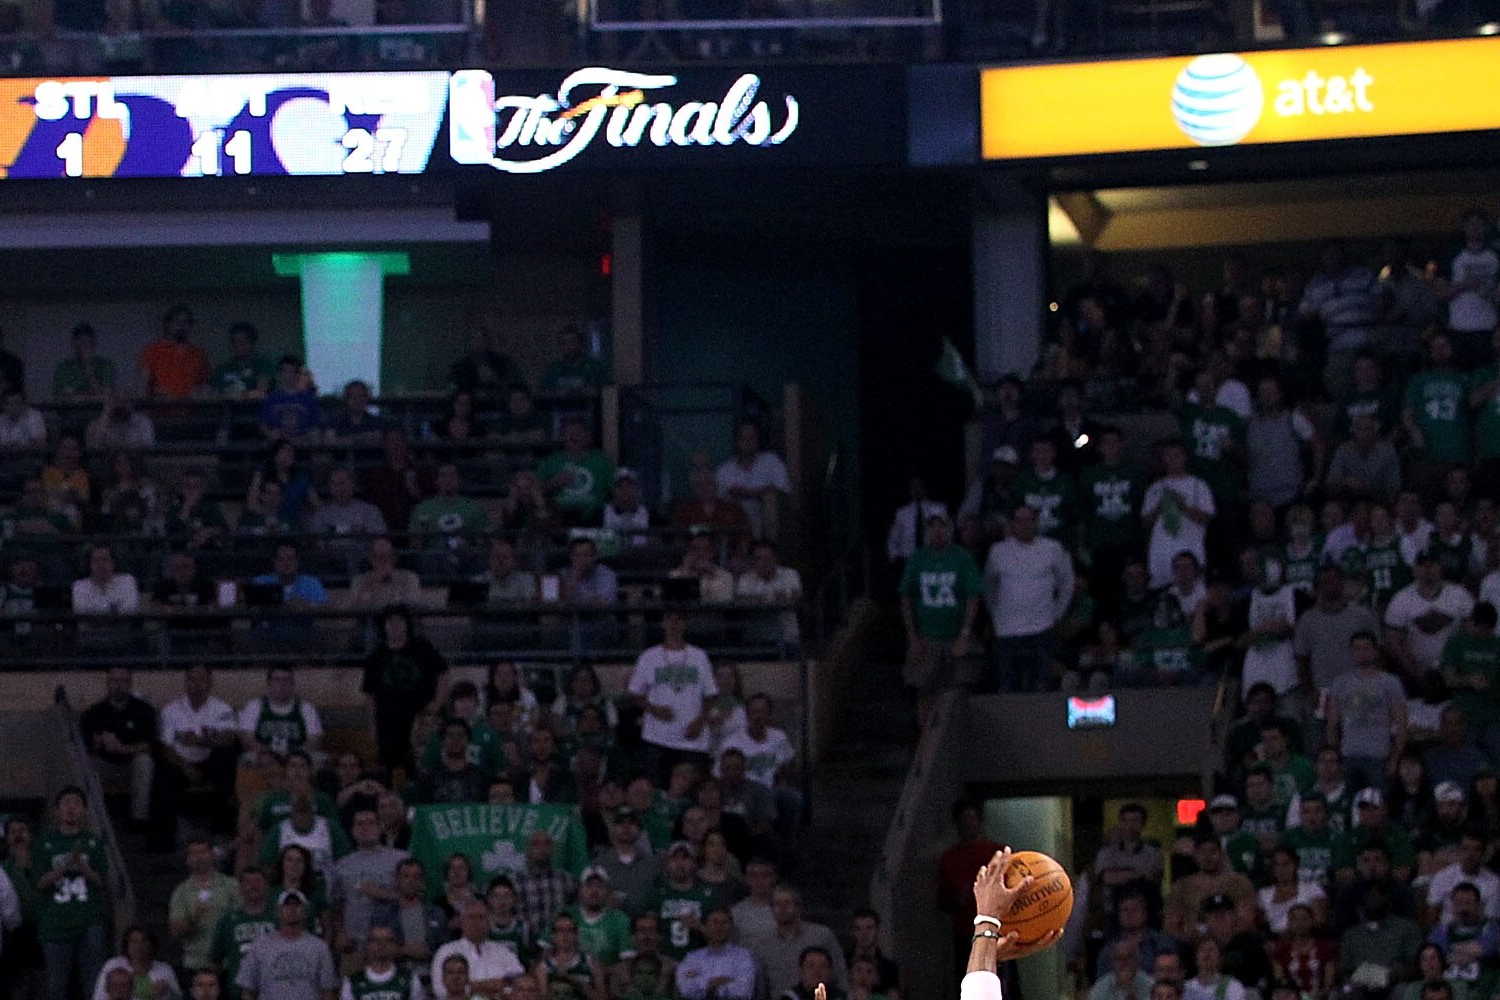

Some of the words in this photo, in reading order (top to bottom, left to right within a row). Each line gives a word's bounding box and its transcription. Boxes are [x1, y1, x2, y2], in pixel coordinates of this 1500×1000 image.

[35, 82, 130, 119] STL
[1274, 67, 1374, 117] at&t
[490, 68, 798, 173] Finals
[496, 94, 562, 148] The
[56, 134, 81, 176] 1
[193, 131, 251, 174] 11
[343, 128, 407, 172] 27
[429, 806, 538, 839] BELIEVE
[53, 879, 87, 902] 34
